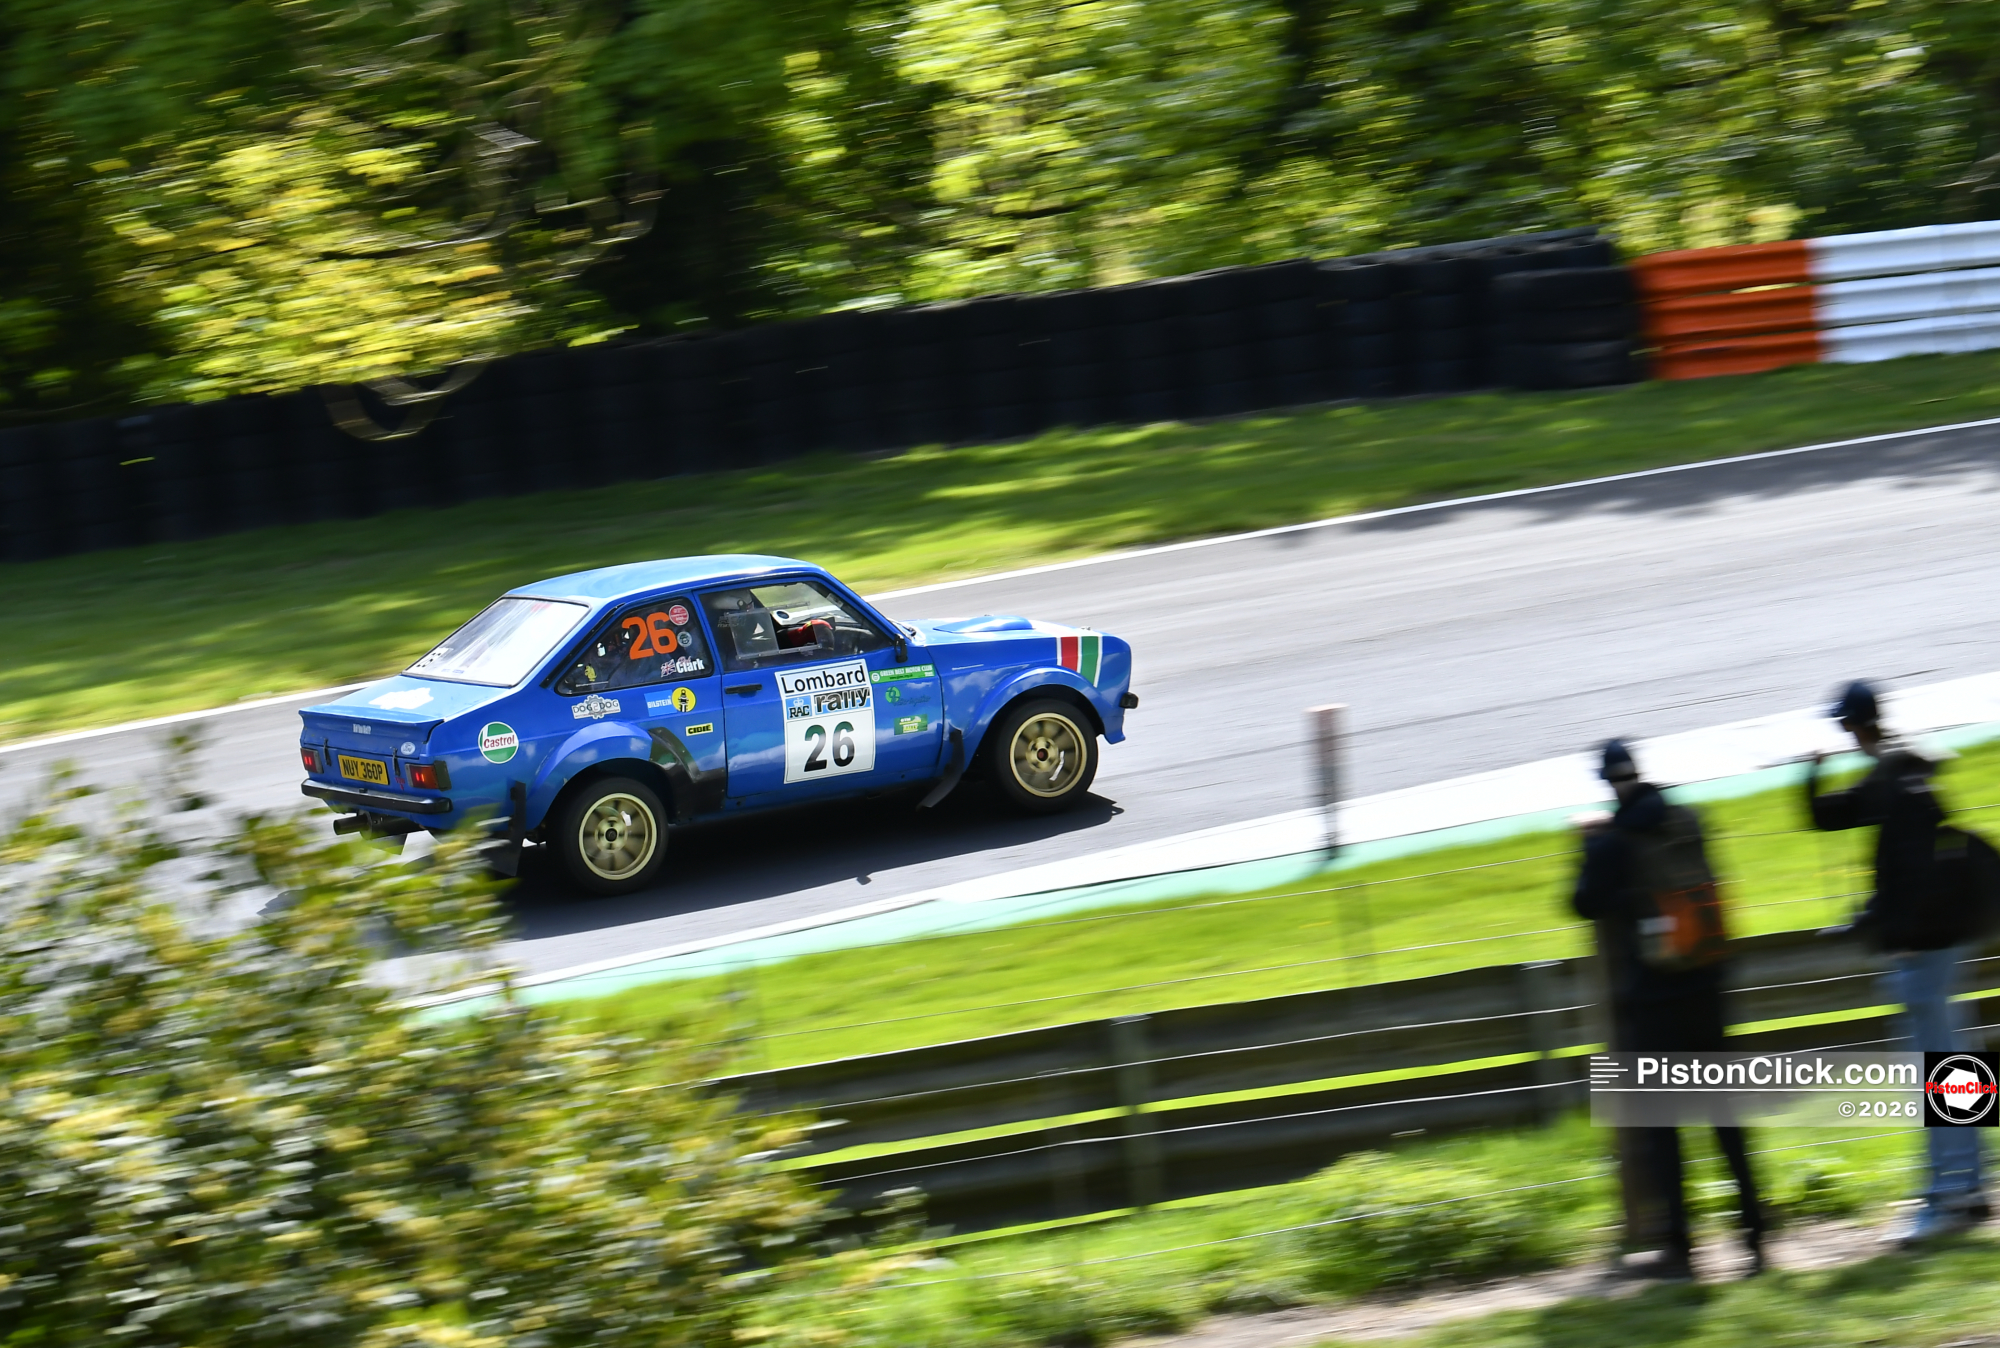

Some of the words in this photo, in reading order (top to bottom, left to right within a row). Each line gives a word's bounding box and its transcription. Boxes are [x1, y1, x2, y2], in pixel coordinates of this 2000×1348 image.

[621, 612, 678, 660] 26
[676, 658, 705, 673] Clark
[780, 665, 866, 694] Lombard
[573, 700, 619, 713] DOG2DOG
[647, 699, 672, 708] BILSTEIN
[815, 687, 870, 713] rally
[789, 705, 810, 718] RAC
[483, 735, 515, 748] Castrol
[804, 721, 855, 772] 26
[342, 759, 360, 777] NUY
[361, 762, 383, 780] 360P
